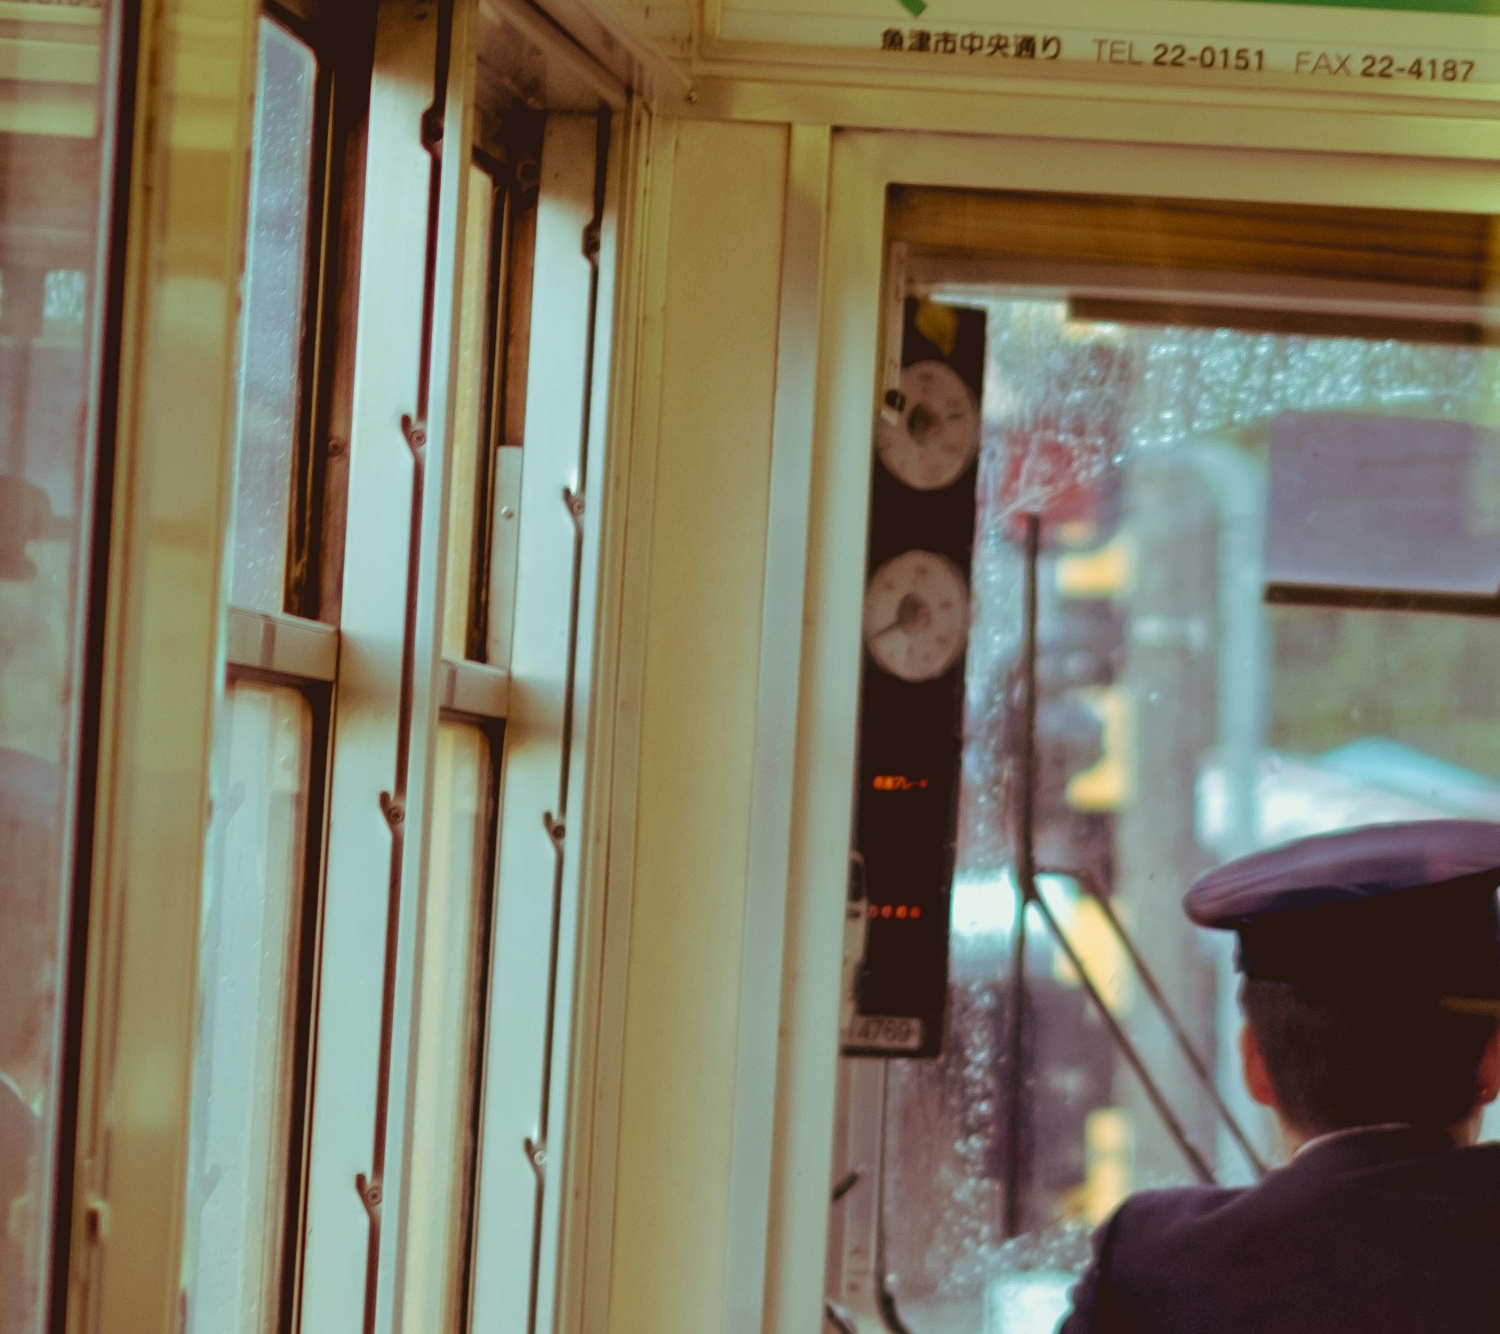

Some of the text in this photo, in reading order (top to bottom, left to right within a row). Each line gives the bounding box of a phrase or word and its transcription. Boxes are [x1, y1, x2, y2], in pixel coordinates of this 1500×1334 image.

[880, 27, 1476, 83] 魚津市中央通り TEL 22-0151 FAX 22-4187
